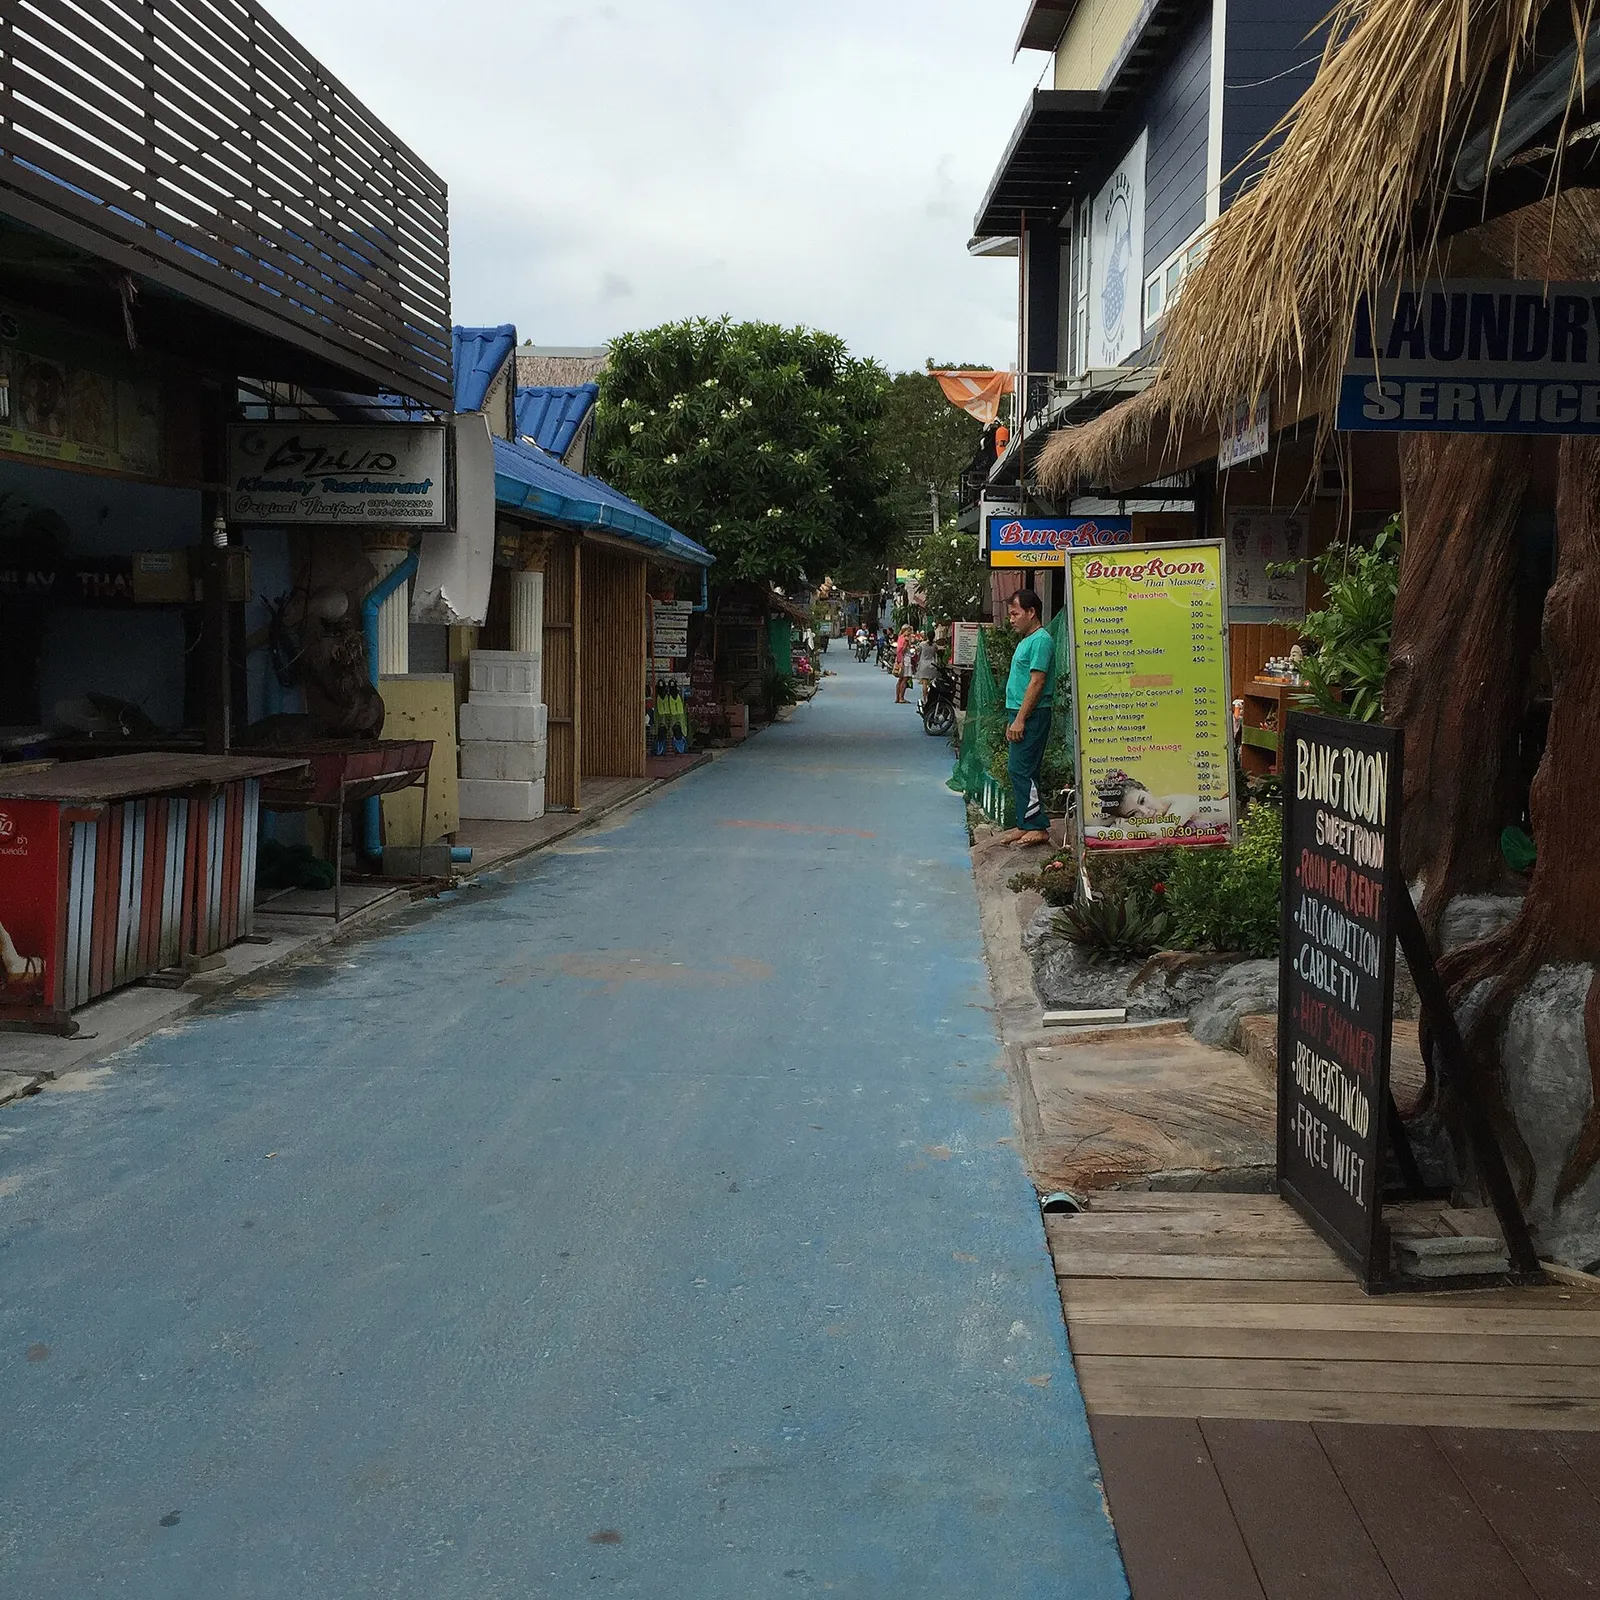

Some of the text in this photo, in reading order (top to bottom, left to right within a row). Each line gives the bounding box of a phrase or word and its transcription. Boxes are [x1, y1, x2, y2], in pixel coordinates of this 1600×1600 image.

[1363, 381, 1600, 424] SERVICE
[320, 477, 434, 494] Restaurant
[235, 495, 298, 518] Original
[1000, 520, 1132, 552] BungRoo
[1038, 553, 1060, 562] Thai
[1085, 557, 1206, 582] BungRoon
[1143, 578, 1207, 589] Thai Massage
[1128, 592, 1168, 600] Relaxation
[1098, 605, 1128, 614] Massage
[1083, 616, 1124, 626] Oil Massage
[1191, 622, 1205, 630] 300
[1100, 628, 1129, 637] Massage
[1104, 639, 1133, 648] Massage
[1084, 651, 1103, 659] Head
[1137, 648, 1166, 656] Shoulder
[1085, 661, 1134, 670] Head Massage
[1087, 691, 1134, 701] Aromatherapy
[1146, 689, 1173, 697] Coconut
[1175, 687, 1184, 696] oil
[1087, 702, 1134, 713] Aromatherapy
[1136, 701, 1148, 709] Hot
[1115, 713, 1145, 723] Massage
[1088, 724, 1146, 734] Swedish Massage
[1089, 737, 1105, 745] After
[1126, 743, 1183, 754] Body Massage
[1088, 754, 1142, 764] Facial treatment
[1089, 768, 1104, 776] Foot
[1296, 737, 1342, 809] BANG
[1342, 749, 1388, 827] ROON
[1198, 795, 1211, 803] 200
[1127, 813, 1182, 828] Open Daily
[1097, 830, 1123, 842] 9.30
[1160, 827, 1192, 840] 10.30
[1315, 808, 1385, 872] SWEET ROOM
[1301, 847, 1383, 922] ROOM FOR RENT
[1299, 893, 1381, 979] AIR CONDITION
[1299, 943, 1338, 997] CABLE
[1300, 989, 1327, 1044] HOT
[1295, 1039, 1343, 1114] BREAKFAST
[1297, 1101, 1328, 1170] FREE
